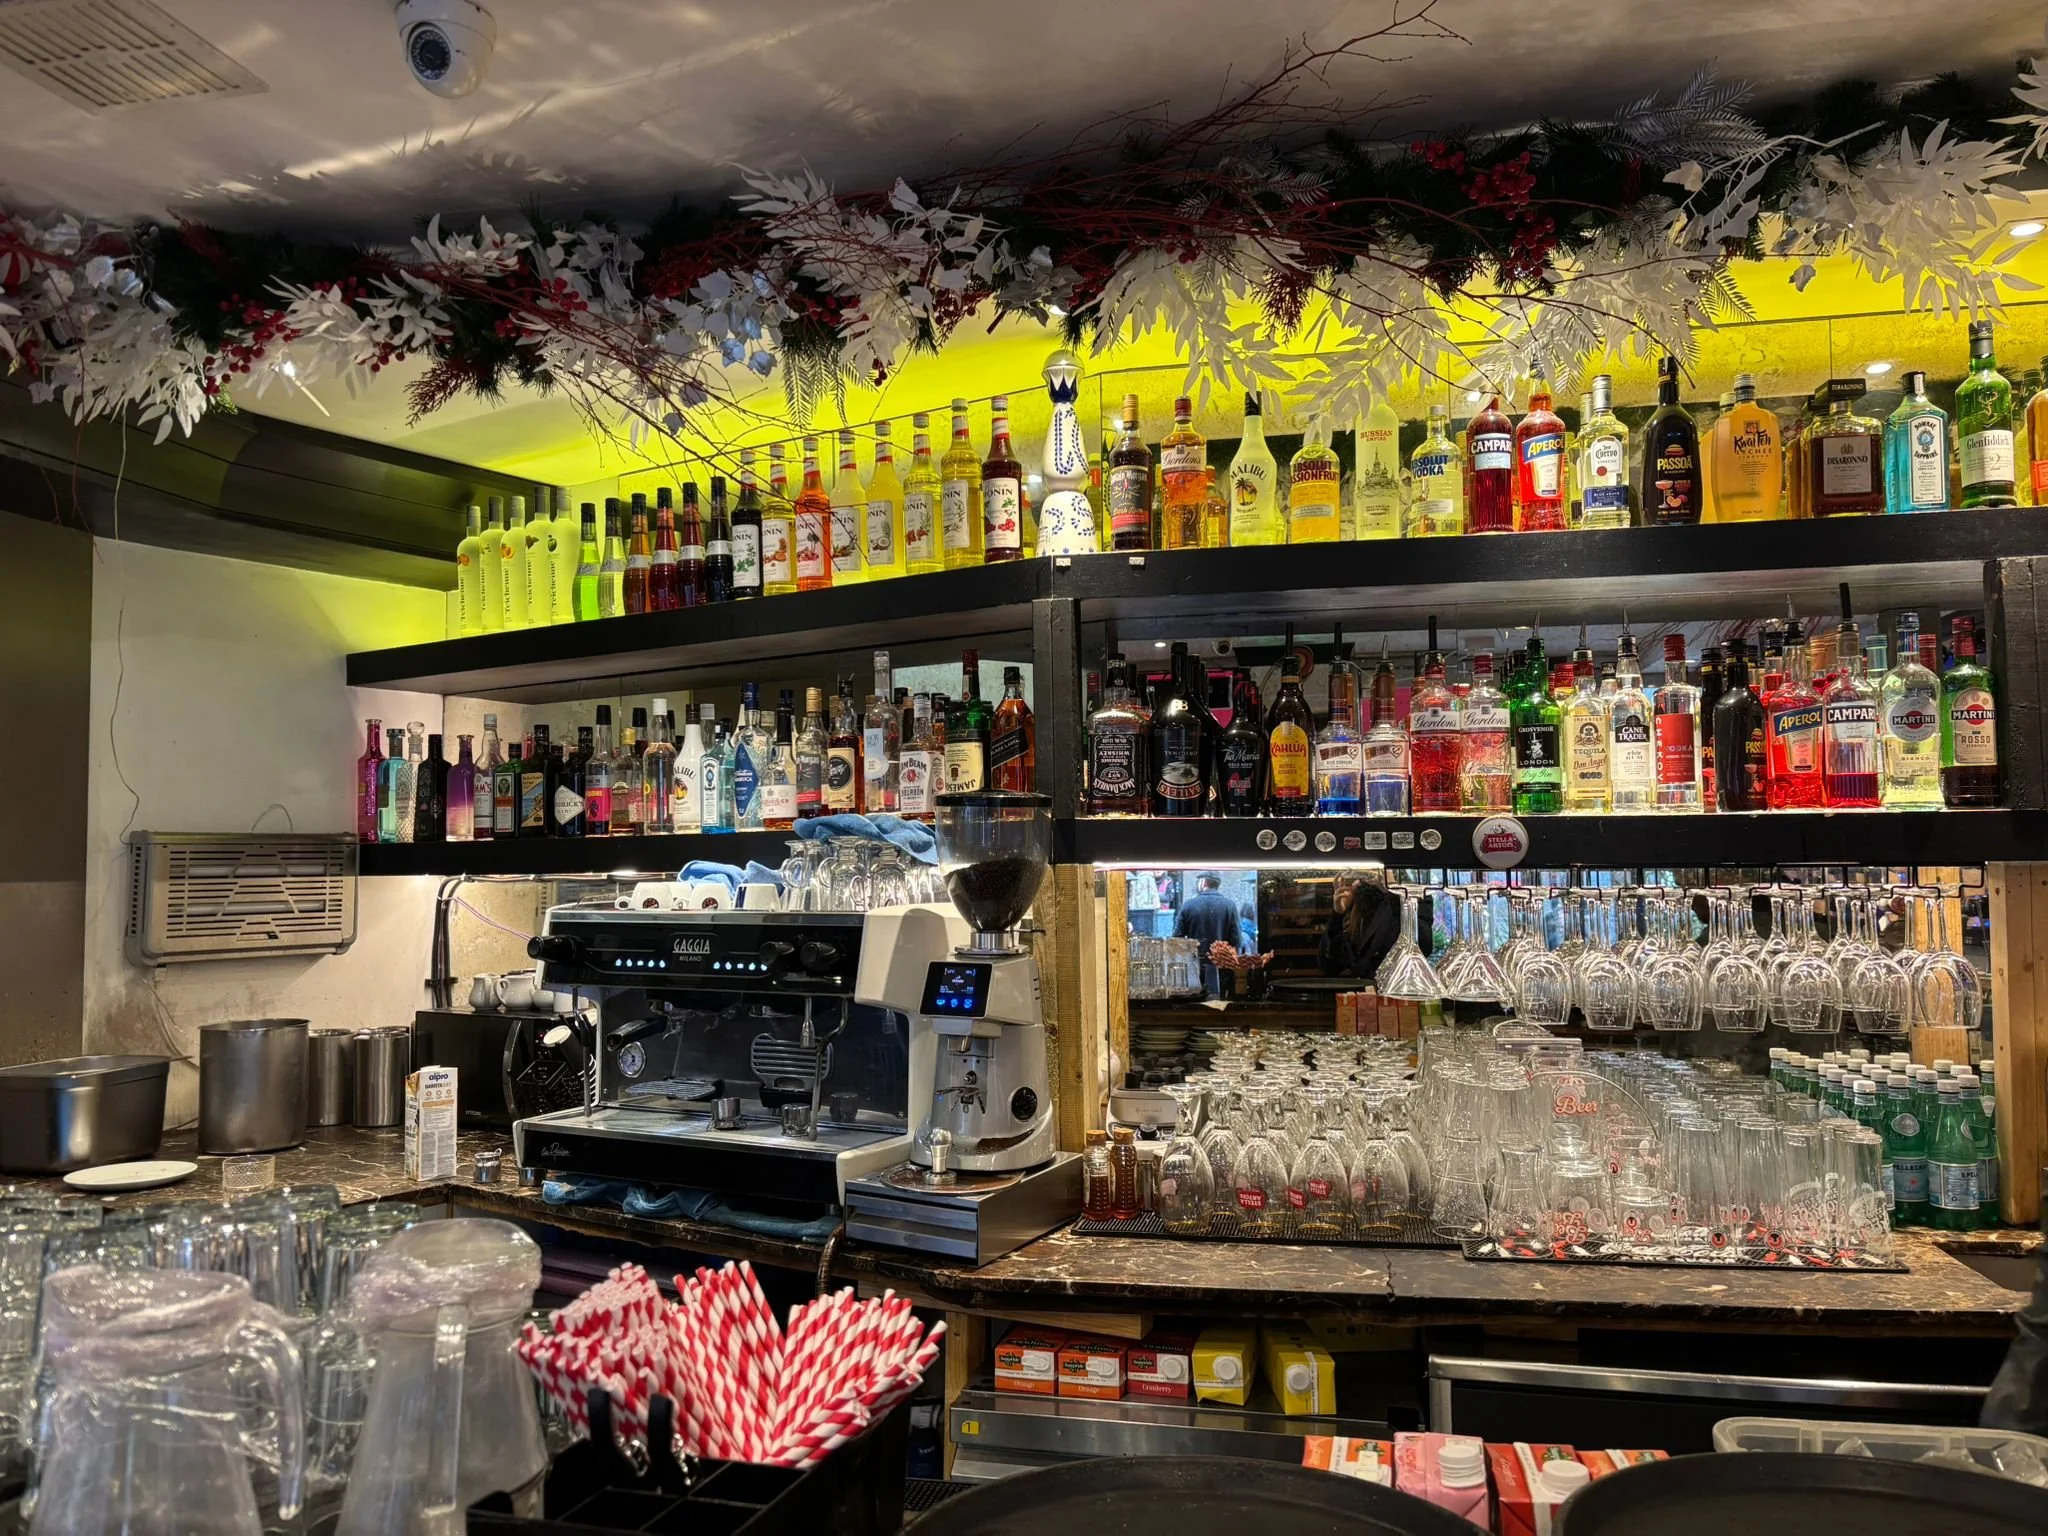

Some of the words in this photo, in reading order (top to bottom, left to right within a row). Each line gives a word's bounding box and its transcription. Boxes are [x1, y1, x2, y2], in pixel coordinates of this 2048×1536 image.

[1360, 429, 1393, 440] RUSSIAN
[1966, 432, 2010, 450] Glenfiddich
[1471, 439, 1512, 454] CAMPAR
[1161, 451, 1202, 466] Gordon's
[1595, 448, 1618, 460] Cuervo
[1827, 455, 1868, 466] DISARONNO
[905, 501, 927, 512] ONIN
[1463, 711, 1507, 727] Gordon's
[1778, 711, 1821, 732] APEROL
[1893, 715, 1935, 725] MARTINI
[1952, 710, 1995, 720] MARTINI
[1413, 715, 1457, 729] Gordon's
[1621, 726, 1644, 734] CANE
[1618, 733, 1648, 742] TRADER
[1961, 735, 1991, 744] ROSSO
[1233, 748, 1260, 762] Maria
[1573, 748, 1607, 757] TEQUILA
[908, 757, 927, 772] BEAM
[1092, 777, 1119, 795] DANIEL'S
[1119, 777, 1136, 793] JACK
[1159, 784, 1201, 797] BAILEYS
[673, 938, 711, 954] GAGGIA
[428, 1072, 449, 1082] alpro
[1555, 1096, 1597, 1114] Beer
[1141, 1383, 1173, 1394] Cranberry
